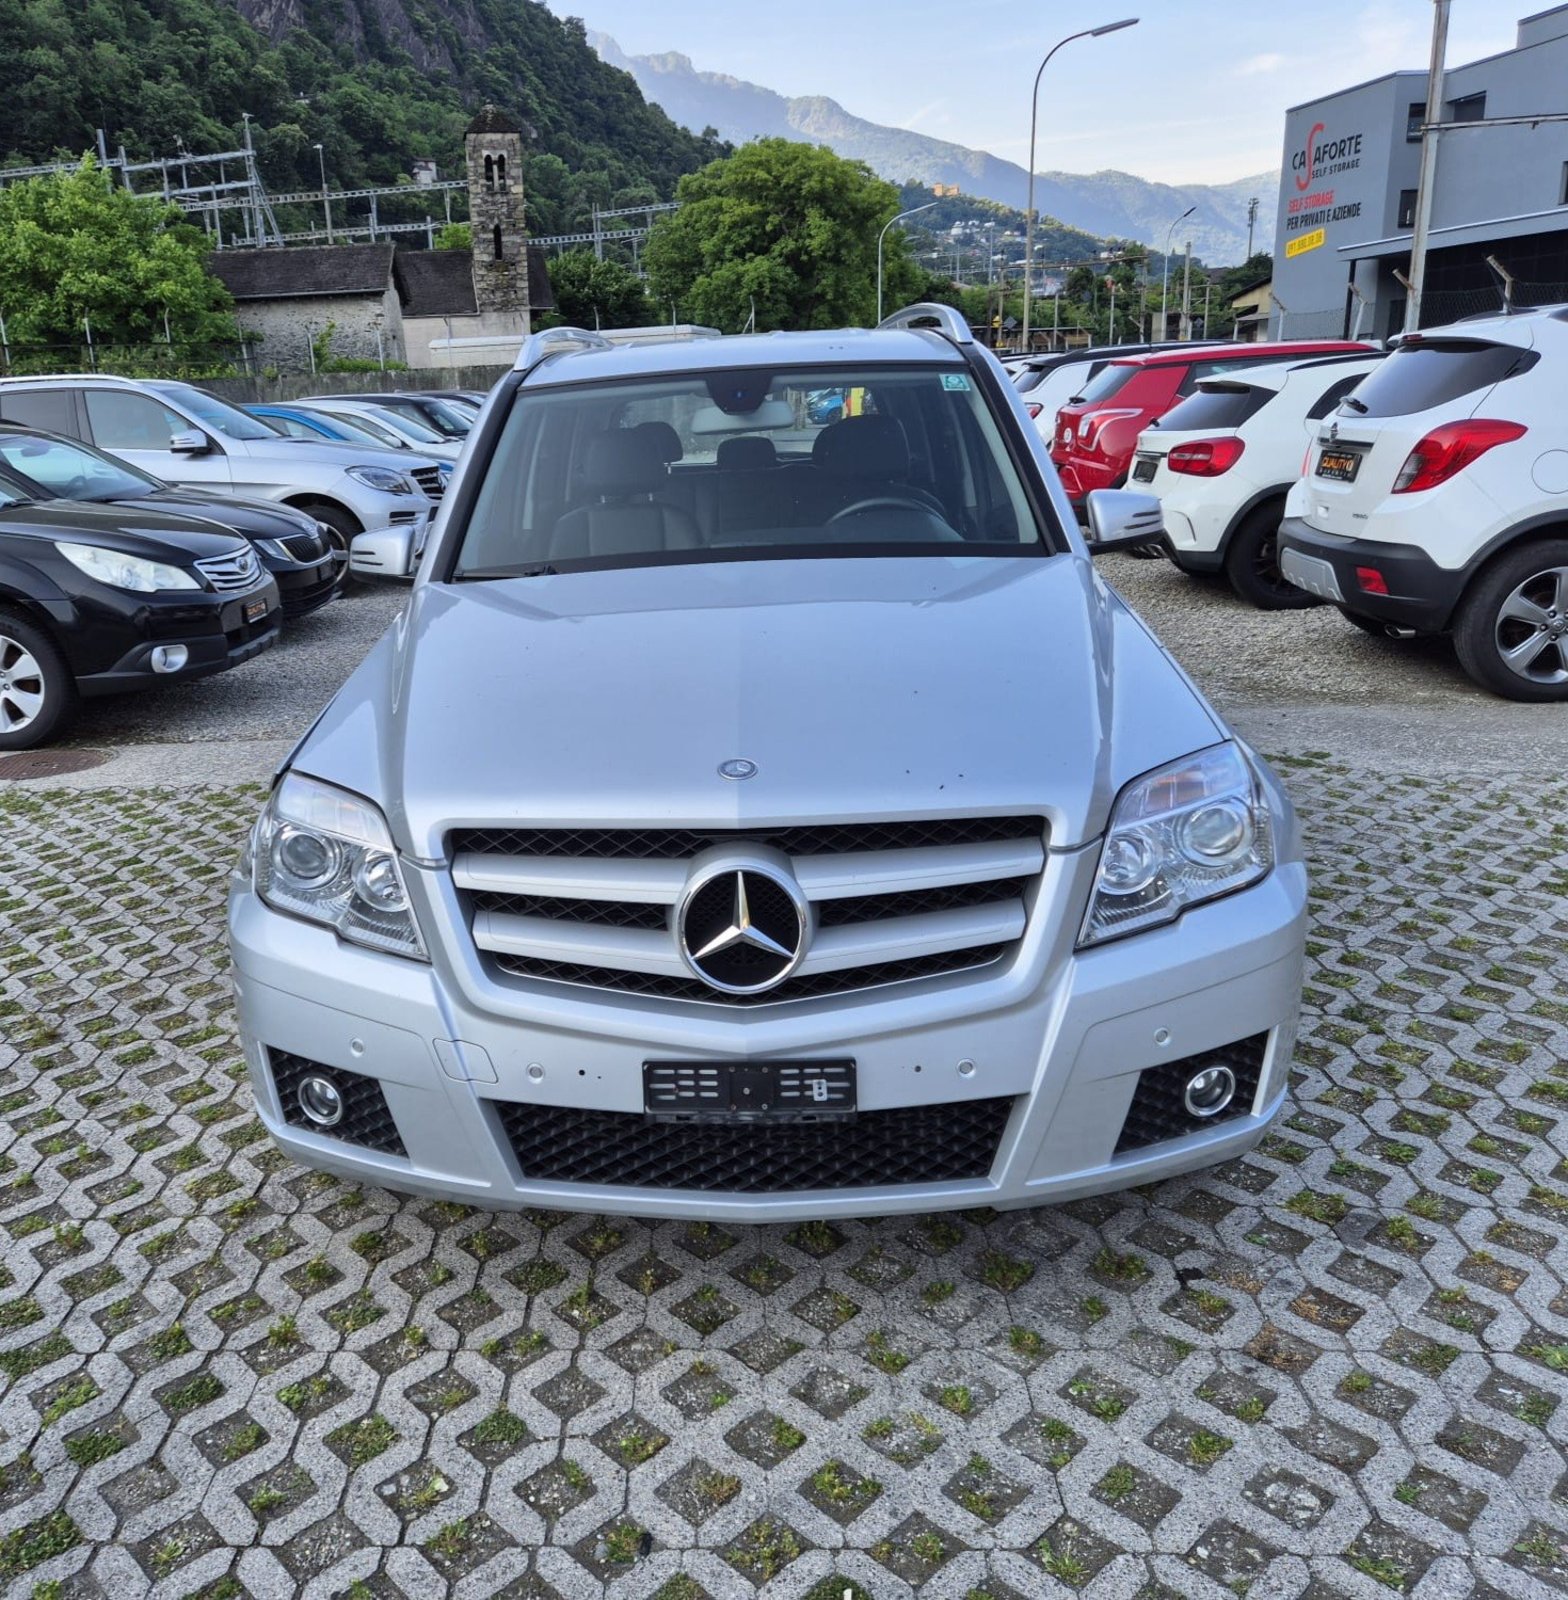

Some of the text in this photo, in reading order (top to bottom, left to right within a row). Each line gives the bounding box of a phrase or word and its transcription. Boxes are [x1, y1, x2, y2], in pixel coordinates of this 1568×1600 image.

[1292, 122, 1362, 191] CASAFORTE
[1311, 158, 1360, 179] SELF STORAGE
[1288, 190, 1334, 213] SELF STORAGE
[1287, 216, 1299, 230] PER
[1299, 210, 1325, 228] PRIVATI
[1332, 202, 1362, 222] AZIENDE
